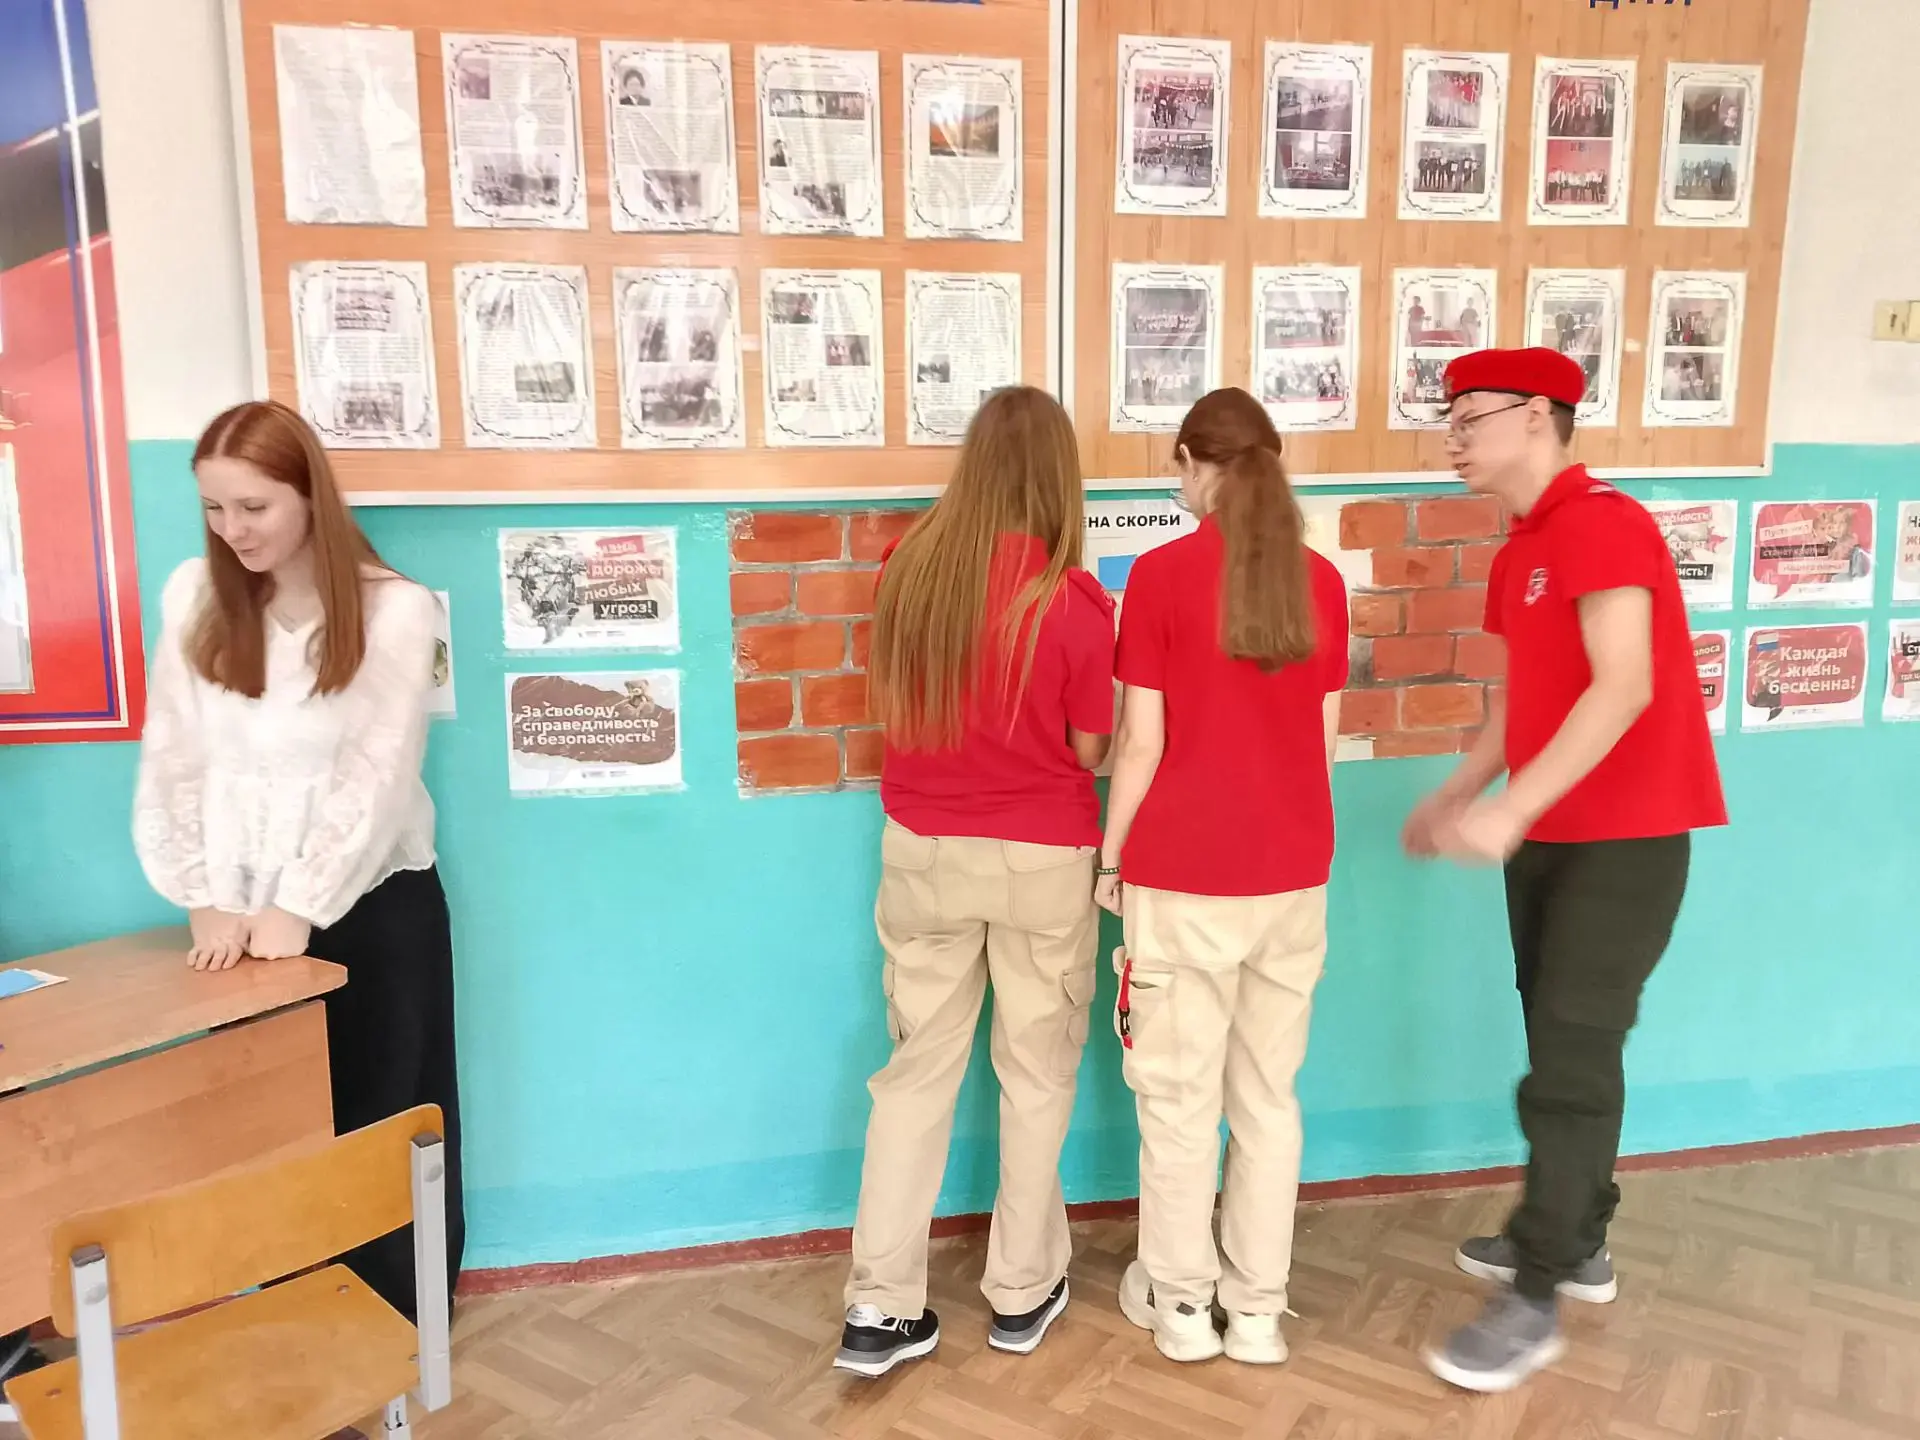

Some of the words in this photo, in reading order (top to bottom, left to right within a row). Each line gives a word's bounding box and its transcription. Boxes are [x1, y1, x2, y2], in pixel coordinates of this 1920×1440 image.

[1083, 517, 1110, 528] НА
[1116, 515, 1181, 527] СКОРБИ
[585, 582, 642, 600] любых
[600, 601, 653, 617] угроз!
[1694, 644, 1720, 657] олоса
[1780, 646, 1848, 661] Каждая
[1786, 664, 1841, 677] жизнь
[1768, 675, 1856, 695] бесценна!
[521, 705, 541, 717] За
[544, 704, 620, 718] свободу,
[522, 719, 659, 736] справедливость
[523, 736, 534, 746] и
[537, 730, 657, 746] безопасность!
